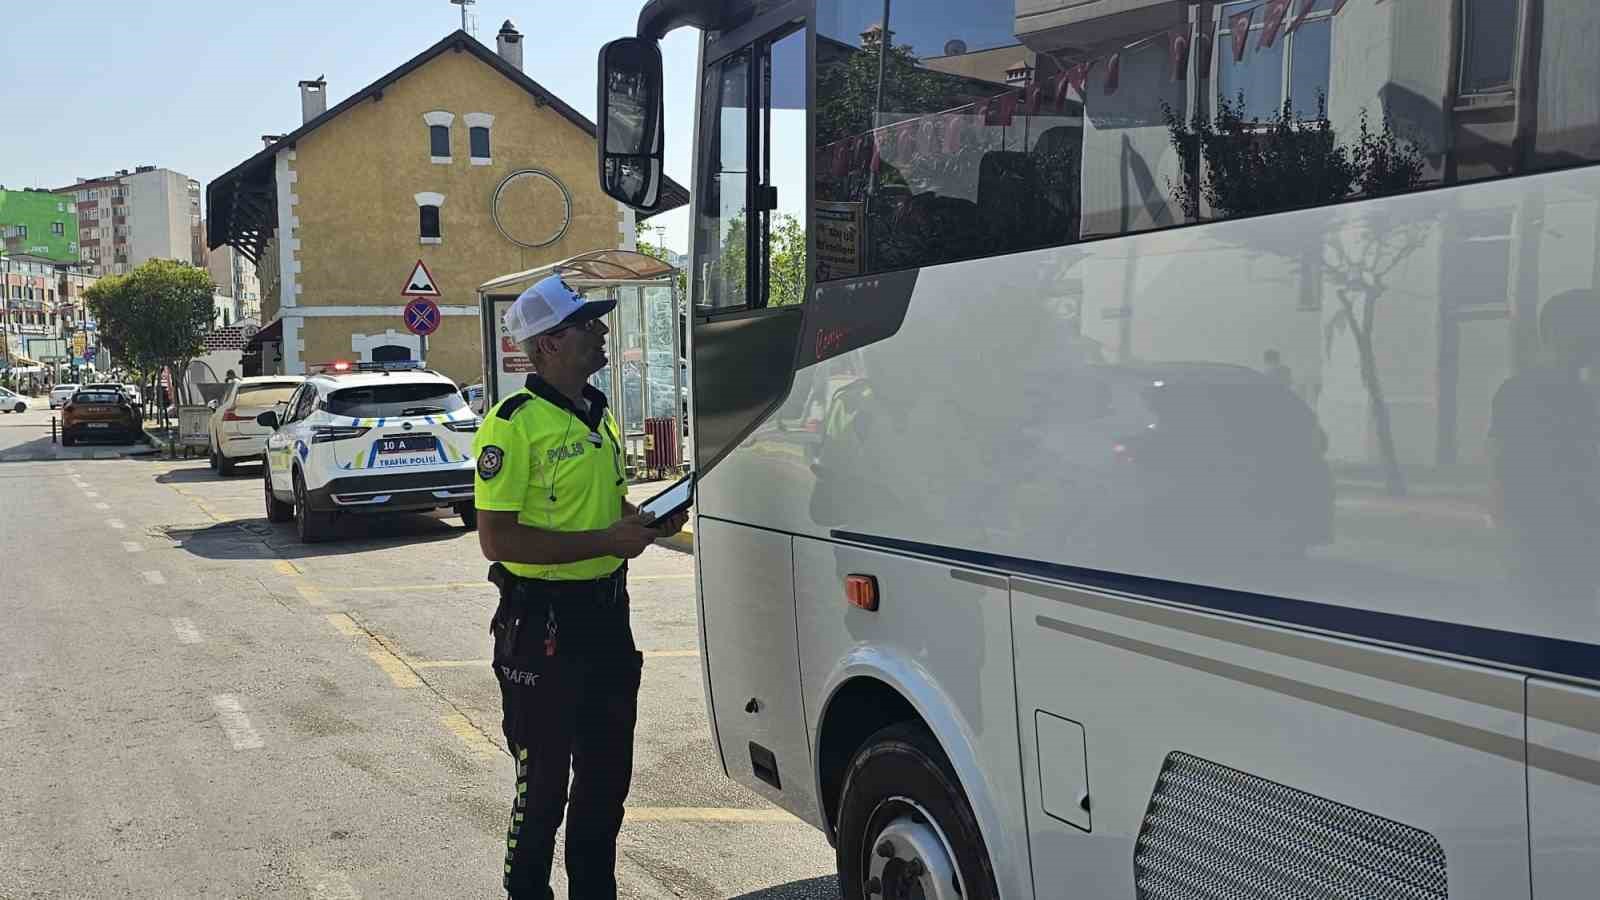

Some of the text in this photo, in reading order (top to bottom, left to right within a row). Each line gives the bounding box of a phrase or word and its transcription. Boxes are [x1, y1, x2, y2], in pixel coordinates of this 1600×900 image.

[383, 441, 406, 450] 10 A
[500, 665, 541, 687] RAFİK
